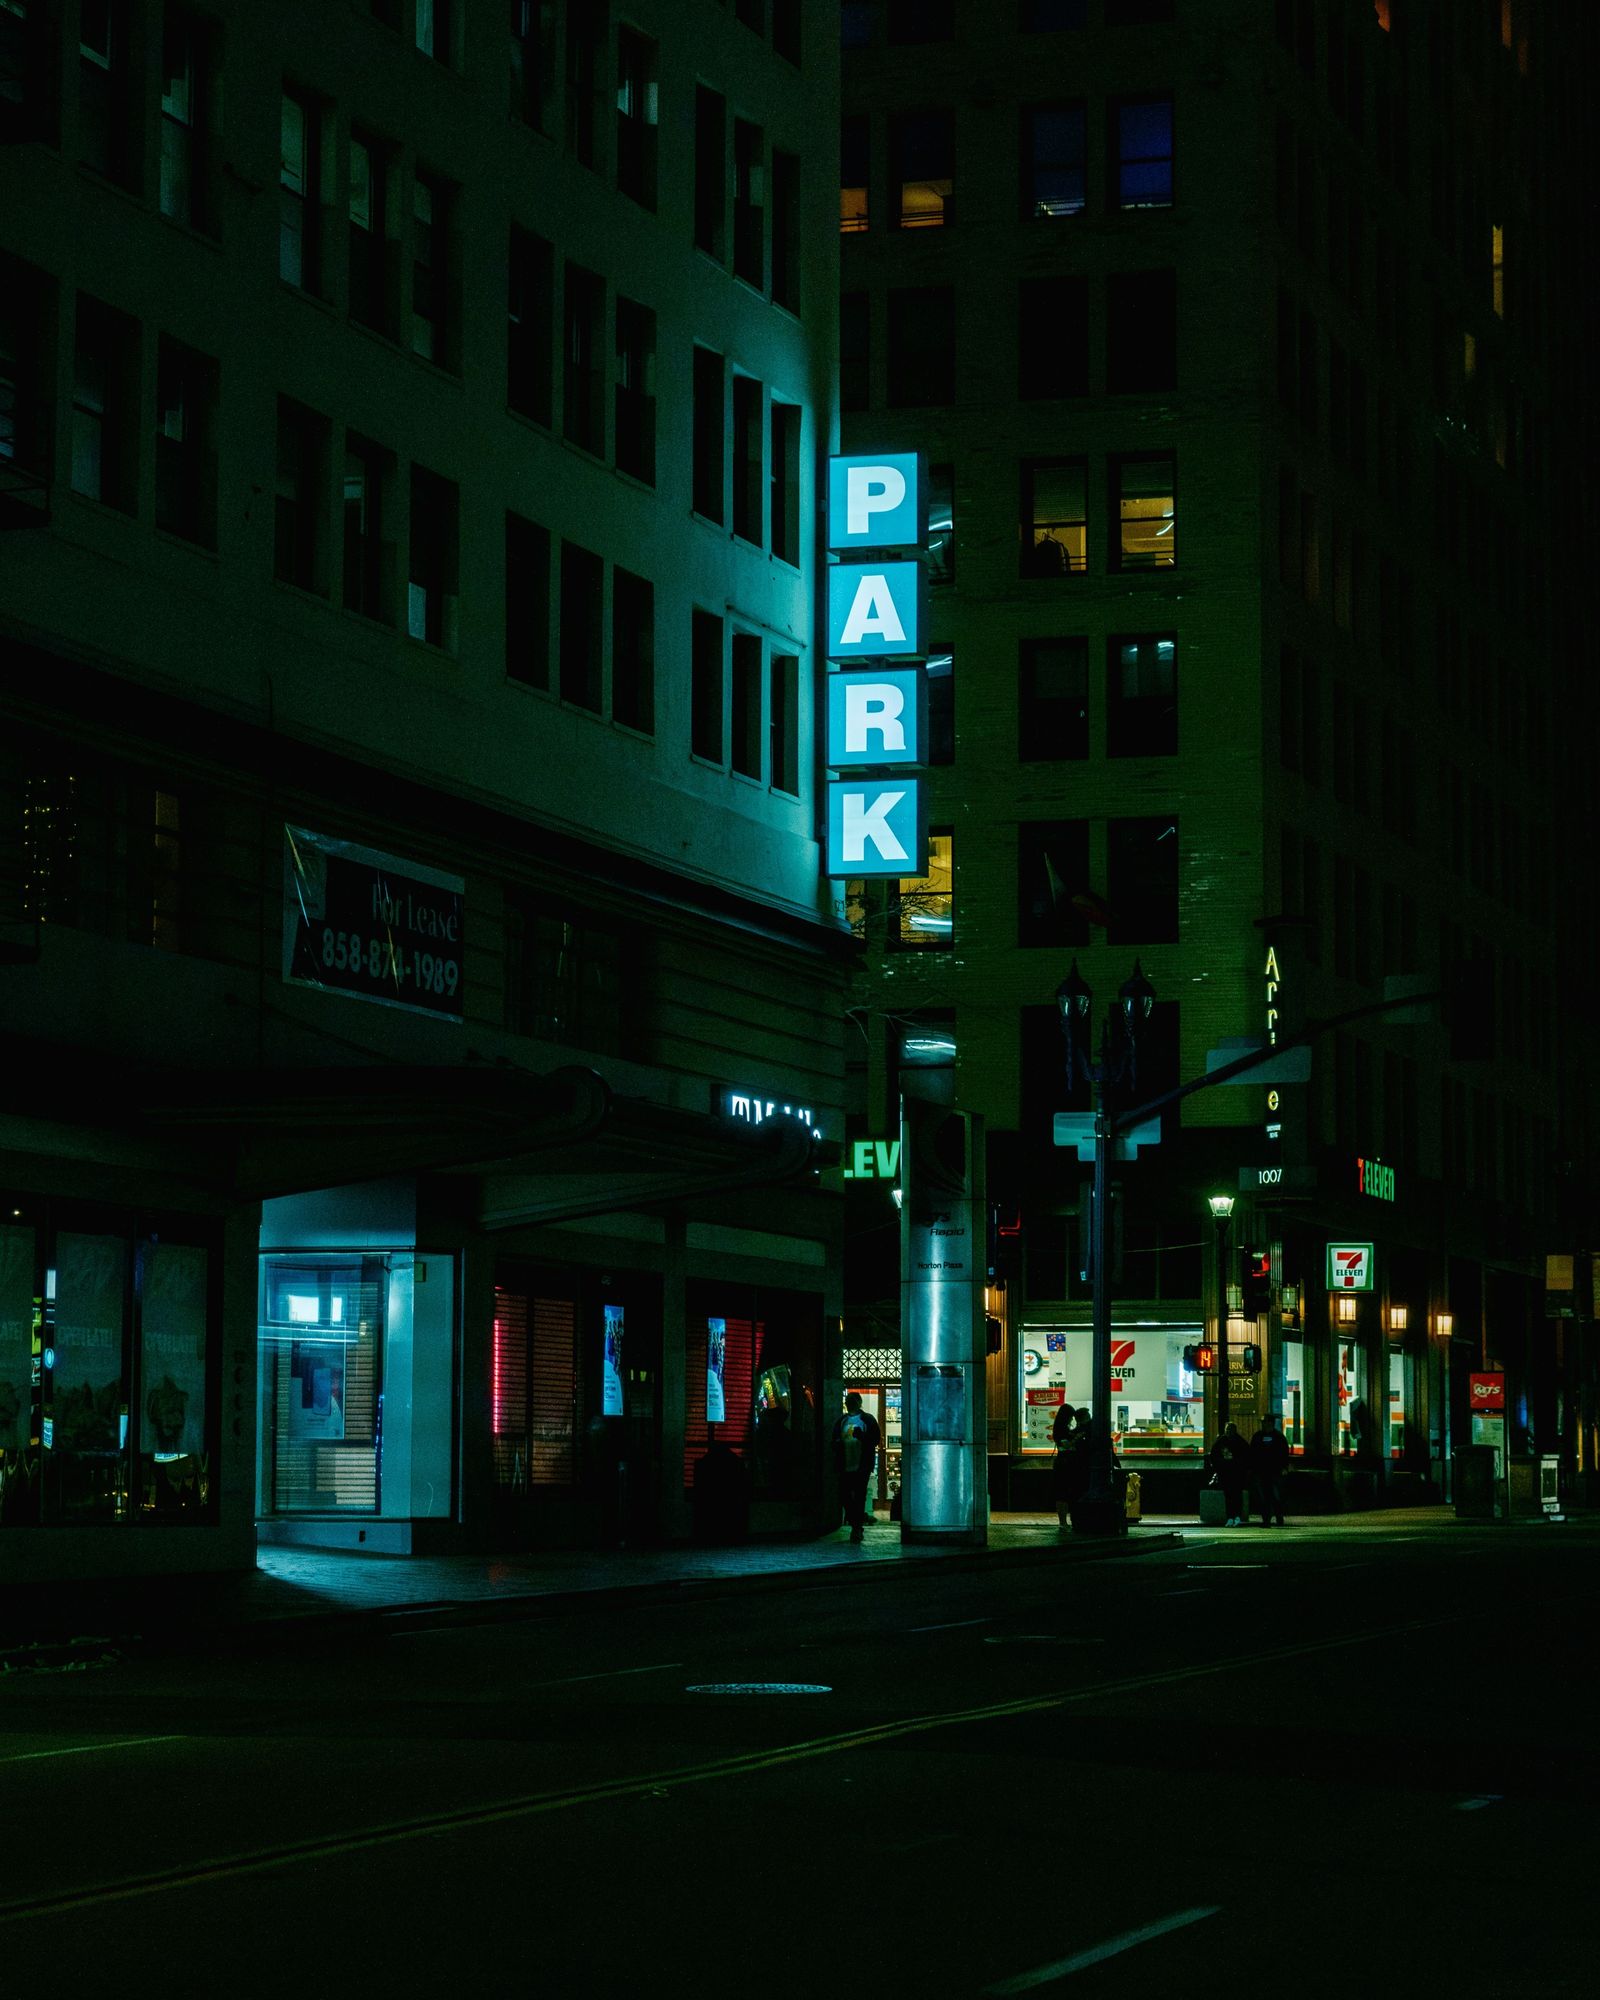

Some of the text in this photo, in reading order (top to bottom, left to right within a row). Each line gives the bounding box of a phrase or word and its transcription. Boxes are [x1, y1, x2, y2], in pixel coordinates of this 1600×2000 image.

[839, 465, 909, 862] PARK
[408, 893, 459, 943] Lease
[1258, 1168, 1282, 1184] 1007
[930, 1227, 965, 1237] Rapid
